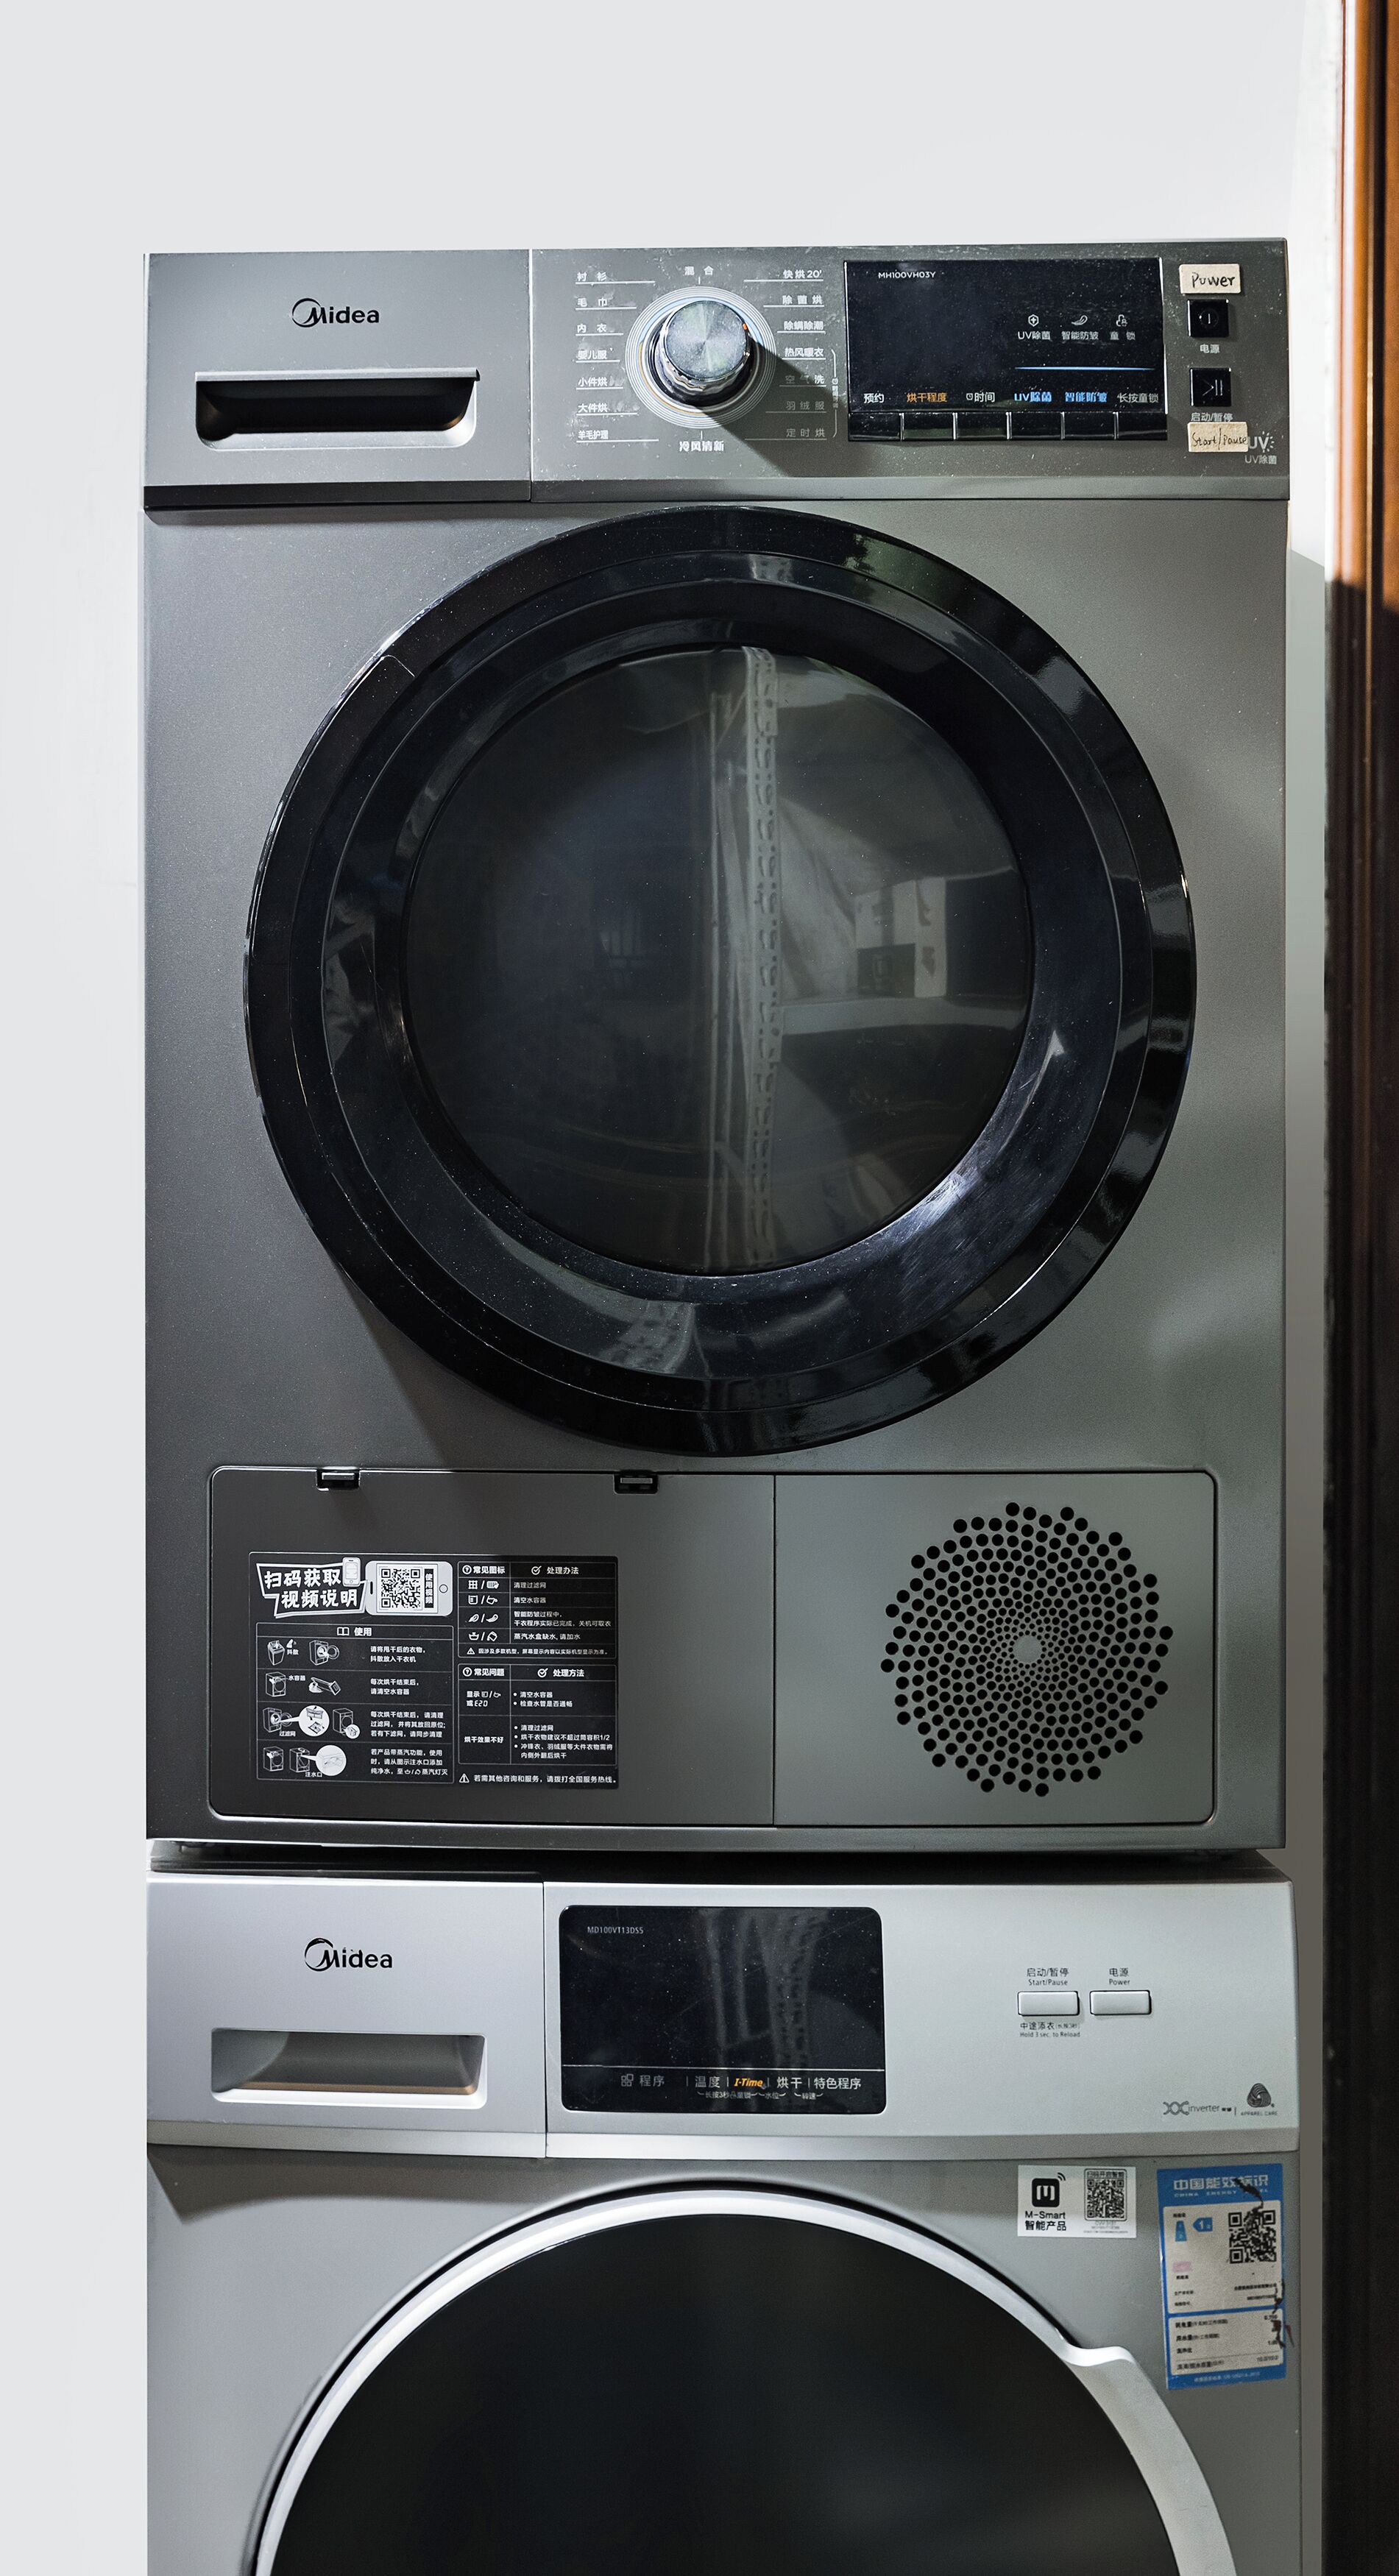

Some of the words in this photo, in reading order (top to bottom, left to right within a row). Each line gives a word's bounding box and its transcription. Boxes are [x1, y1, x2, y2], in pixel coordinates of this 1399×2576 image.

[685, 266, 714, 276] 混合
[577, 272, 607, 282] 衬衫
[577, 297, 608, 308] 毛巾
[782, 294, 823, 305] 除菌烘
[291, 298, 380, 328] Midea
[577, 323, 607, 333] 内衣
[784, 321, 824, 331] 除螨除潮
[1017, 331, 1051, 340] UV除菌
[1061, 330, 1099, 340] 智能防皱
[1110, 330, 1136, 341] 童锁
[784, 347, 824, 358] 热风暖衣
[1200, 344, 1220, 354] 电源
[578, 350, 607, 360] 婴儿服
[578, 376, 608, 387] 小件烘
[863, 392, 885, 403] 预约
[907, 392, 948, 403] 烘干程度
[974, 392, 996, 403] 时间
[1014, 392, 1052, 403] UV除菌
[1065, 392, 1108, 403] 智能防皱
[1117, 392, 1159, 403] 长按童锁
[578, 403, 608, 413] 大件烘
[786, 400, 825, 411] 羽绒服
[1191, 412, 1233, 422] 启动/暂停
[578, 430, 609, 440] 羊毛护理
[786, 428, 826, 437] 定时烘
[679, 441, 725, 452] 冷风清新
[1244, 455, 1278, 464] UV除菌
[473, 1565, 506, 1574] 常见图标
[547, 1566, 579, 1575] 处理办法
[263, 1568, 342, 1589] 扫码获取
[281, 1588, 358, 1609] 视频说明
[354, 1627, 372, 1636] 使用
[474, 1668, 505, 1677] 常见问题
[553, 1669, 585, 1677] 处理方法
[304, 1937, 393, 1972] Midea
[1027, 1967, 1069, 1977] 启动/暂停
[1109, 1967, 1129, 1977] 电源
[640, 2075, 665, 2087] 程序
[695, 2076, 720, 2088] 温度
[776, 2076, 803, 2089] 烘干
[814, 2077, 862, 2090] 特色程序
[1024, 2210, 1066, 2220] M-Smart
[1025, 2221, 1066, 2231] 智能产品
